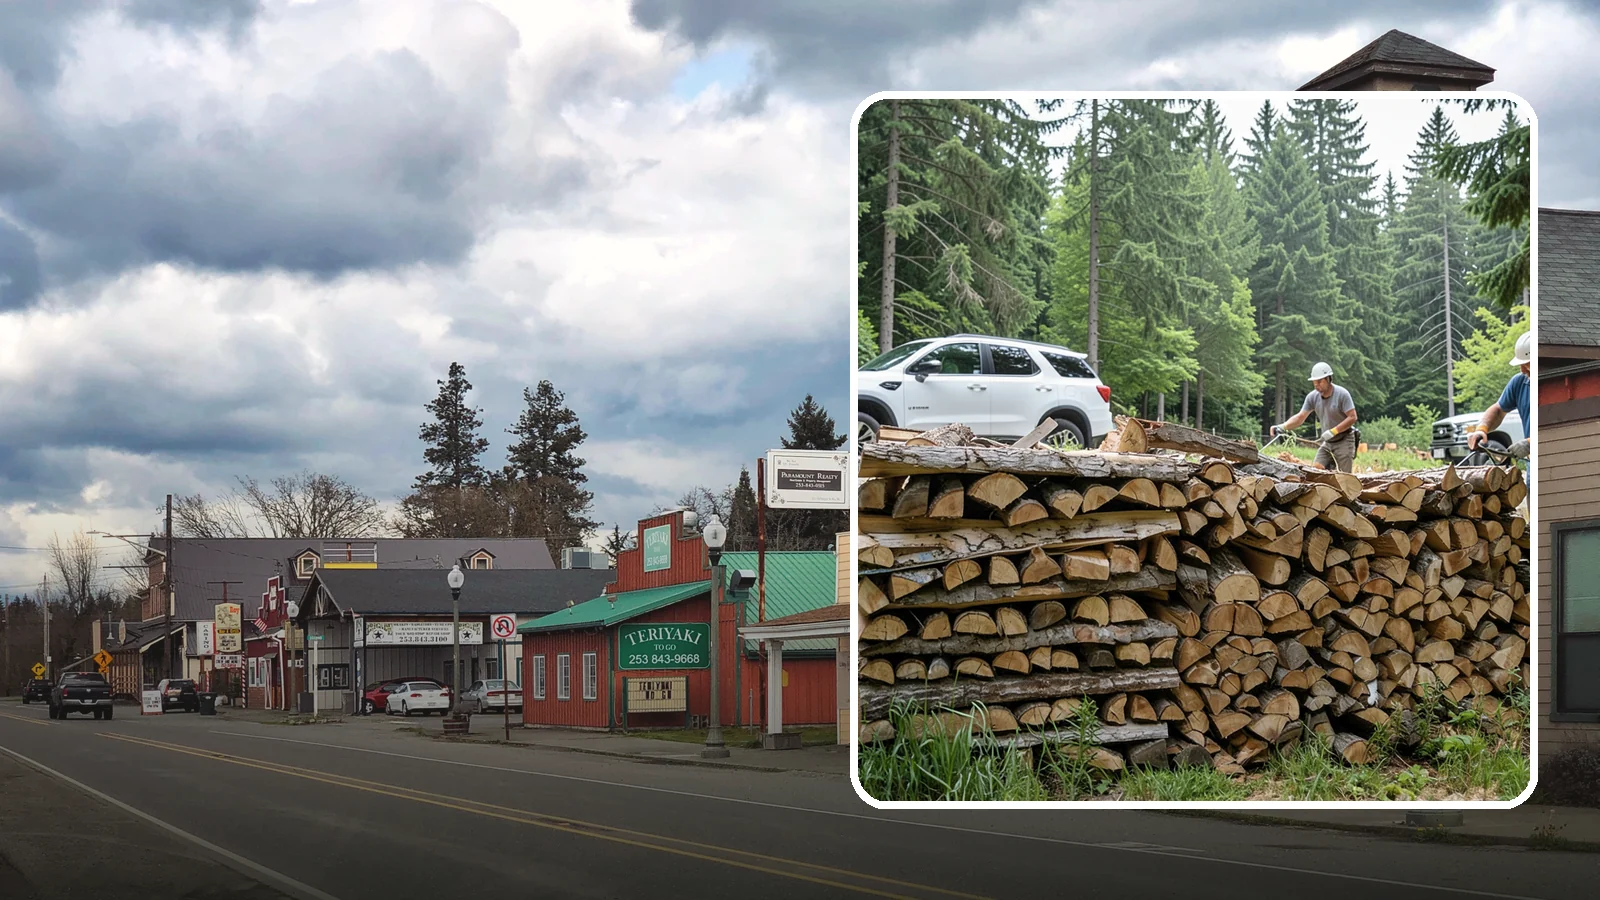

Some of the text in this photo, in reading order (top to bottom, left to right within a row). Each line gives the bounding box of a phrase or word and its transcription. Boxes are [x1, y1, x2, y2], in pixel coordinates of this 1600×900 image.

[781, 471, 839, 480] PARAMOUNT REALTY
[625, 627, 703, 646] TERIYAKI
[629, 654, 700, 665] 253 843-9668
